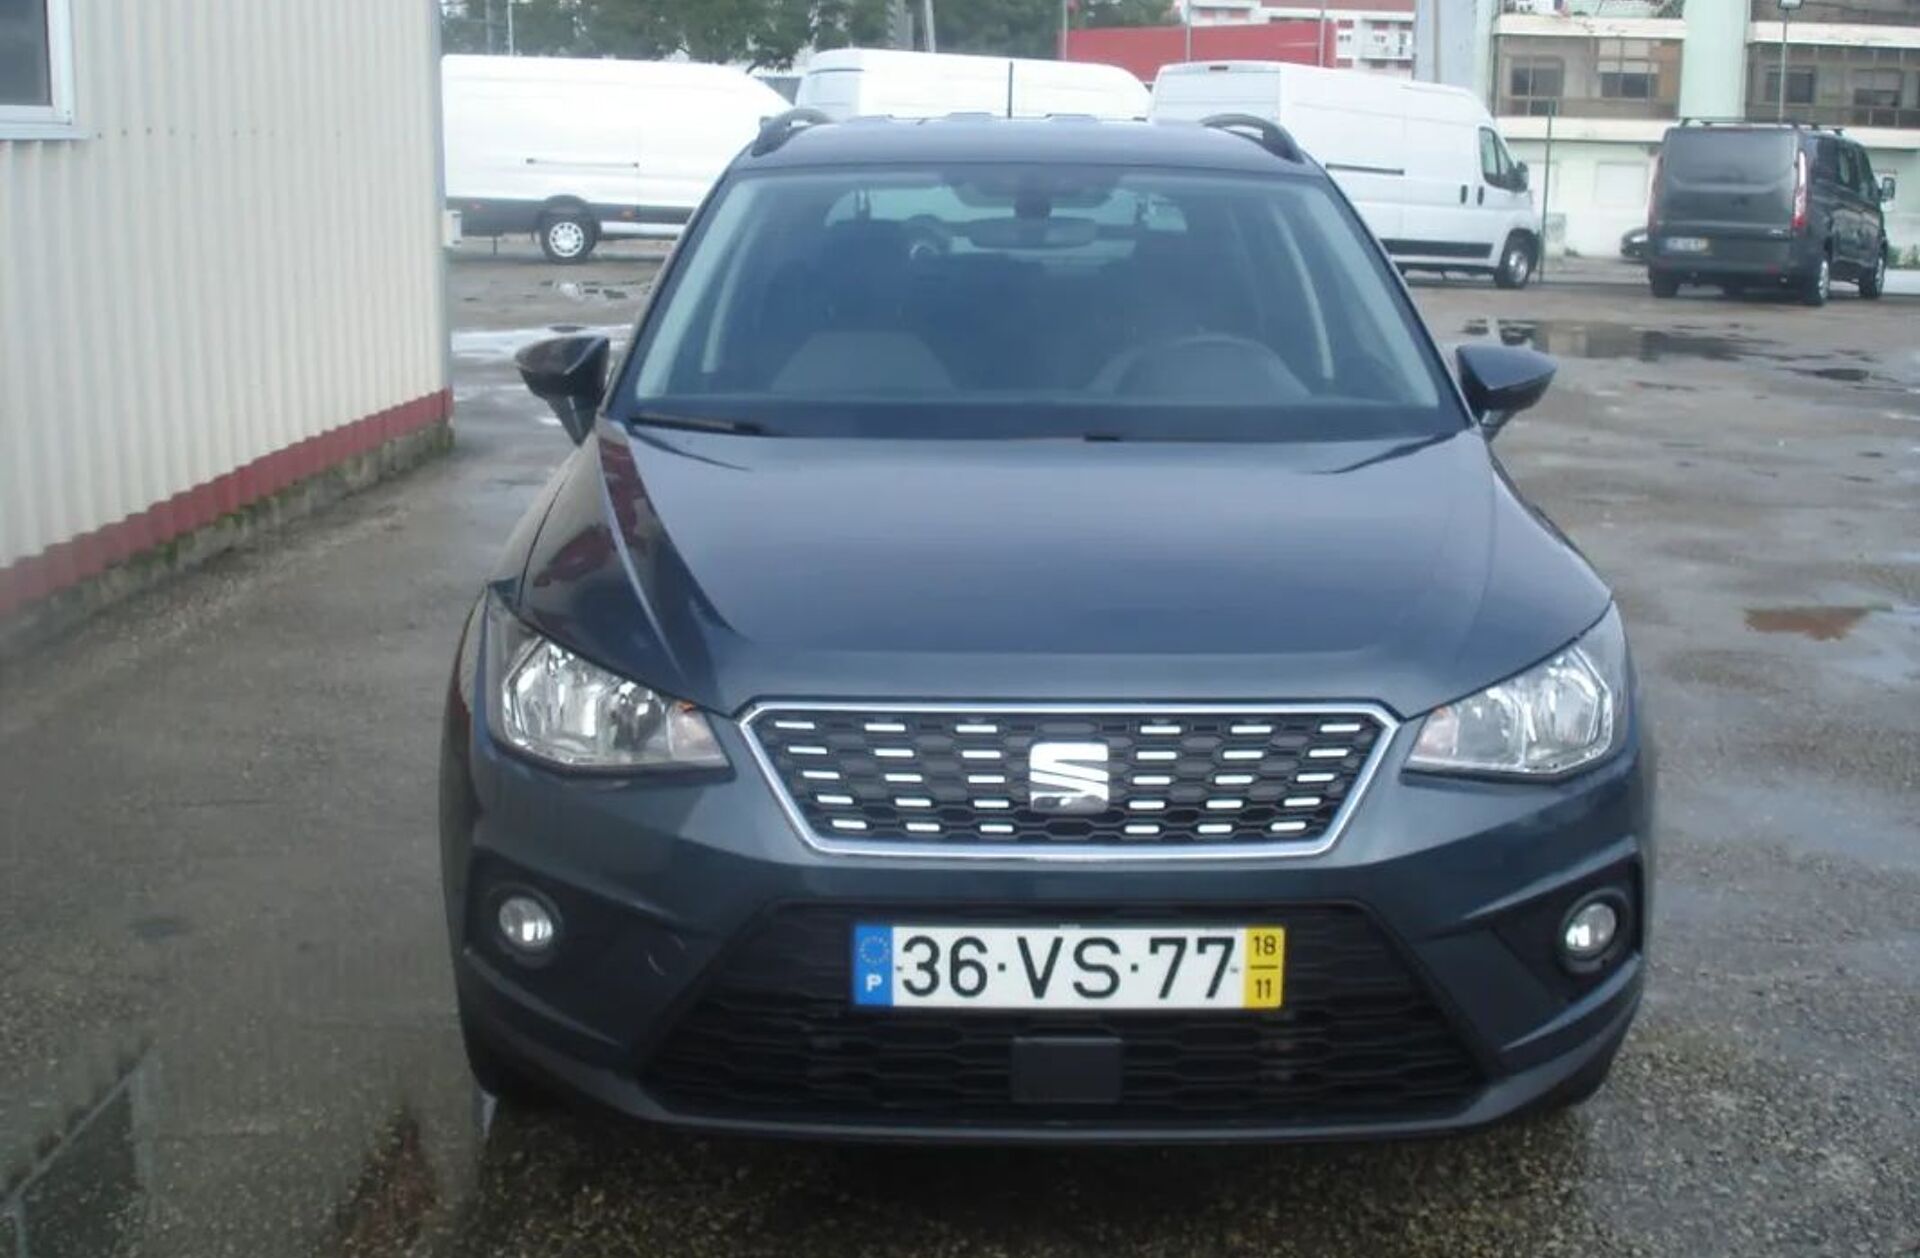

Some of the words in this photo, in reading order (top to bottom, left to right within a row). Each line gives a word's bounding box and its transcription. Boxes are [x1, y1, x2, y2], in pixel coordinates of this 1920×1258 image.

[1254, 935, 1276, 956] 18
[866, 973, 882, 992] P
[1256, 979, 1271, 999] 11
